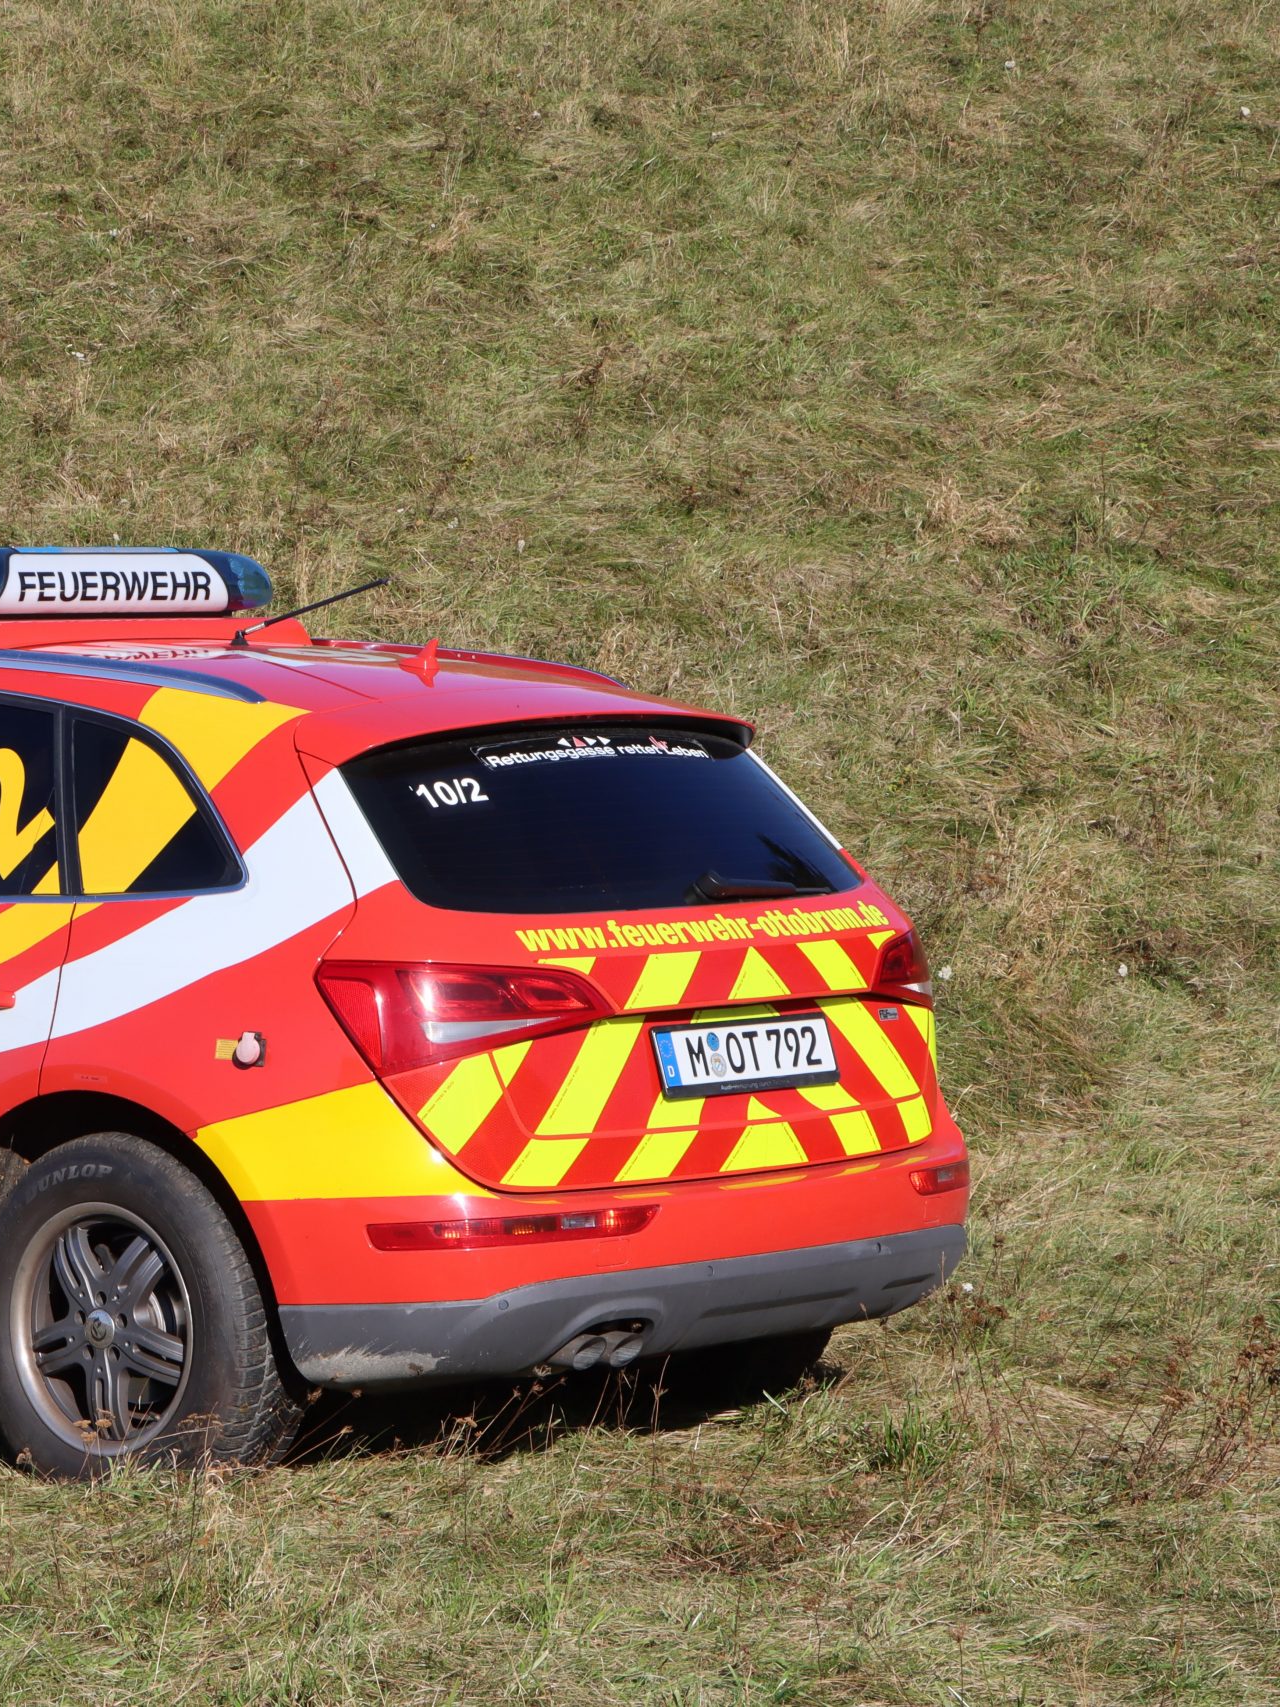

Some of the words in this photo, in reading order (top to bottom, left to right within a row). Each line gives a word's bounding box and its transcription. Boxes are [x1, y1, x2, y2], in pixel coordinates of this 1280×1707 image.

[18, 570, 211, 602] FEUERWEHR
[486, 744, 616, 768] Rettungsgasse
[618, 744, 663, 756] rettet
[664, 746, 709, 759] Leben
[415, 777, 489, 808] 10/2
[515, 900, 889, 951] www.feuerwehr-ottobrunn.de
[685, 1036, 710, 1077] M
